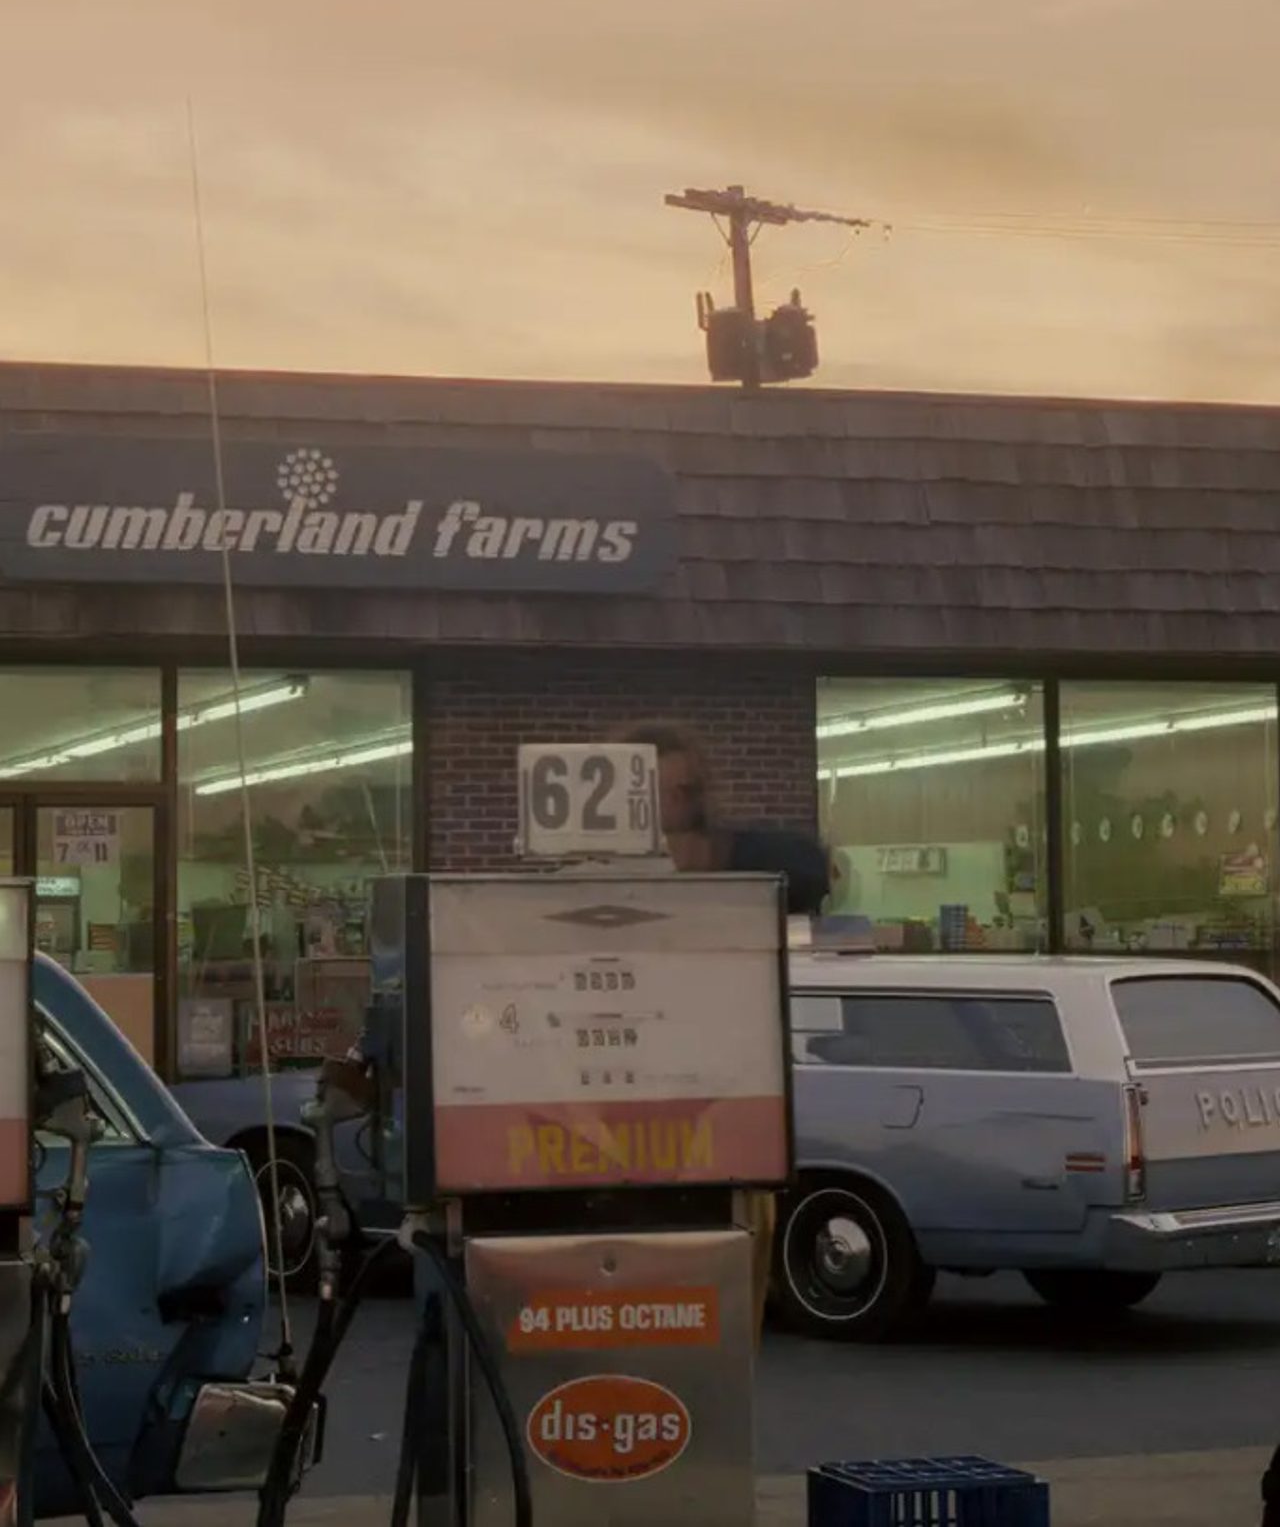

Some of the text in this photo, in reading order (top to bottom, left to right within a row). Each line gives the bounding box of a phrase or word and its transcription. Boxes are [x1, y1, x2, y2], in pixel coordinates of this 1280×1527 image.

[26, 493, 638, 562] cumberland farms
[531, 754, 617, 831] 62
[506, 1117, 715, 1176] PREMIUM
[519, 1302, 706, 1333] 94 PLUS OCTANE
